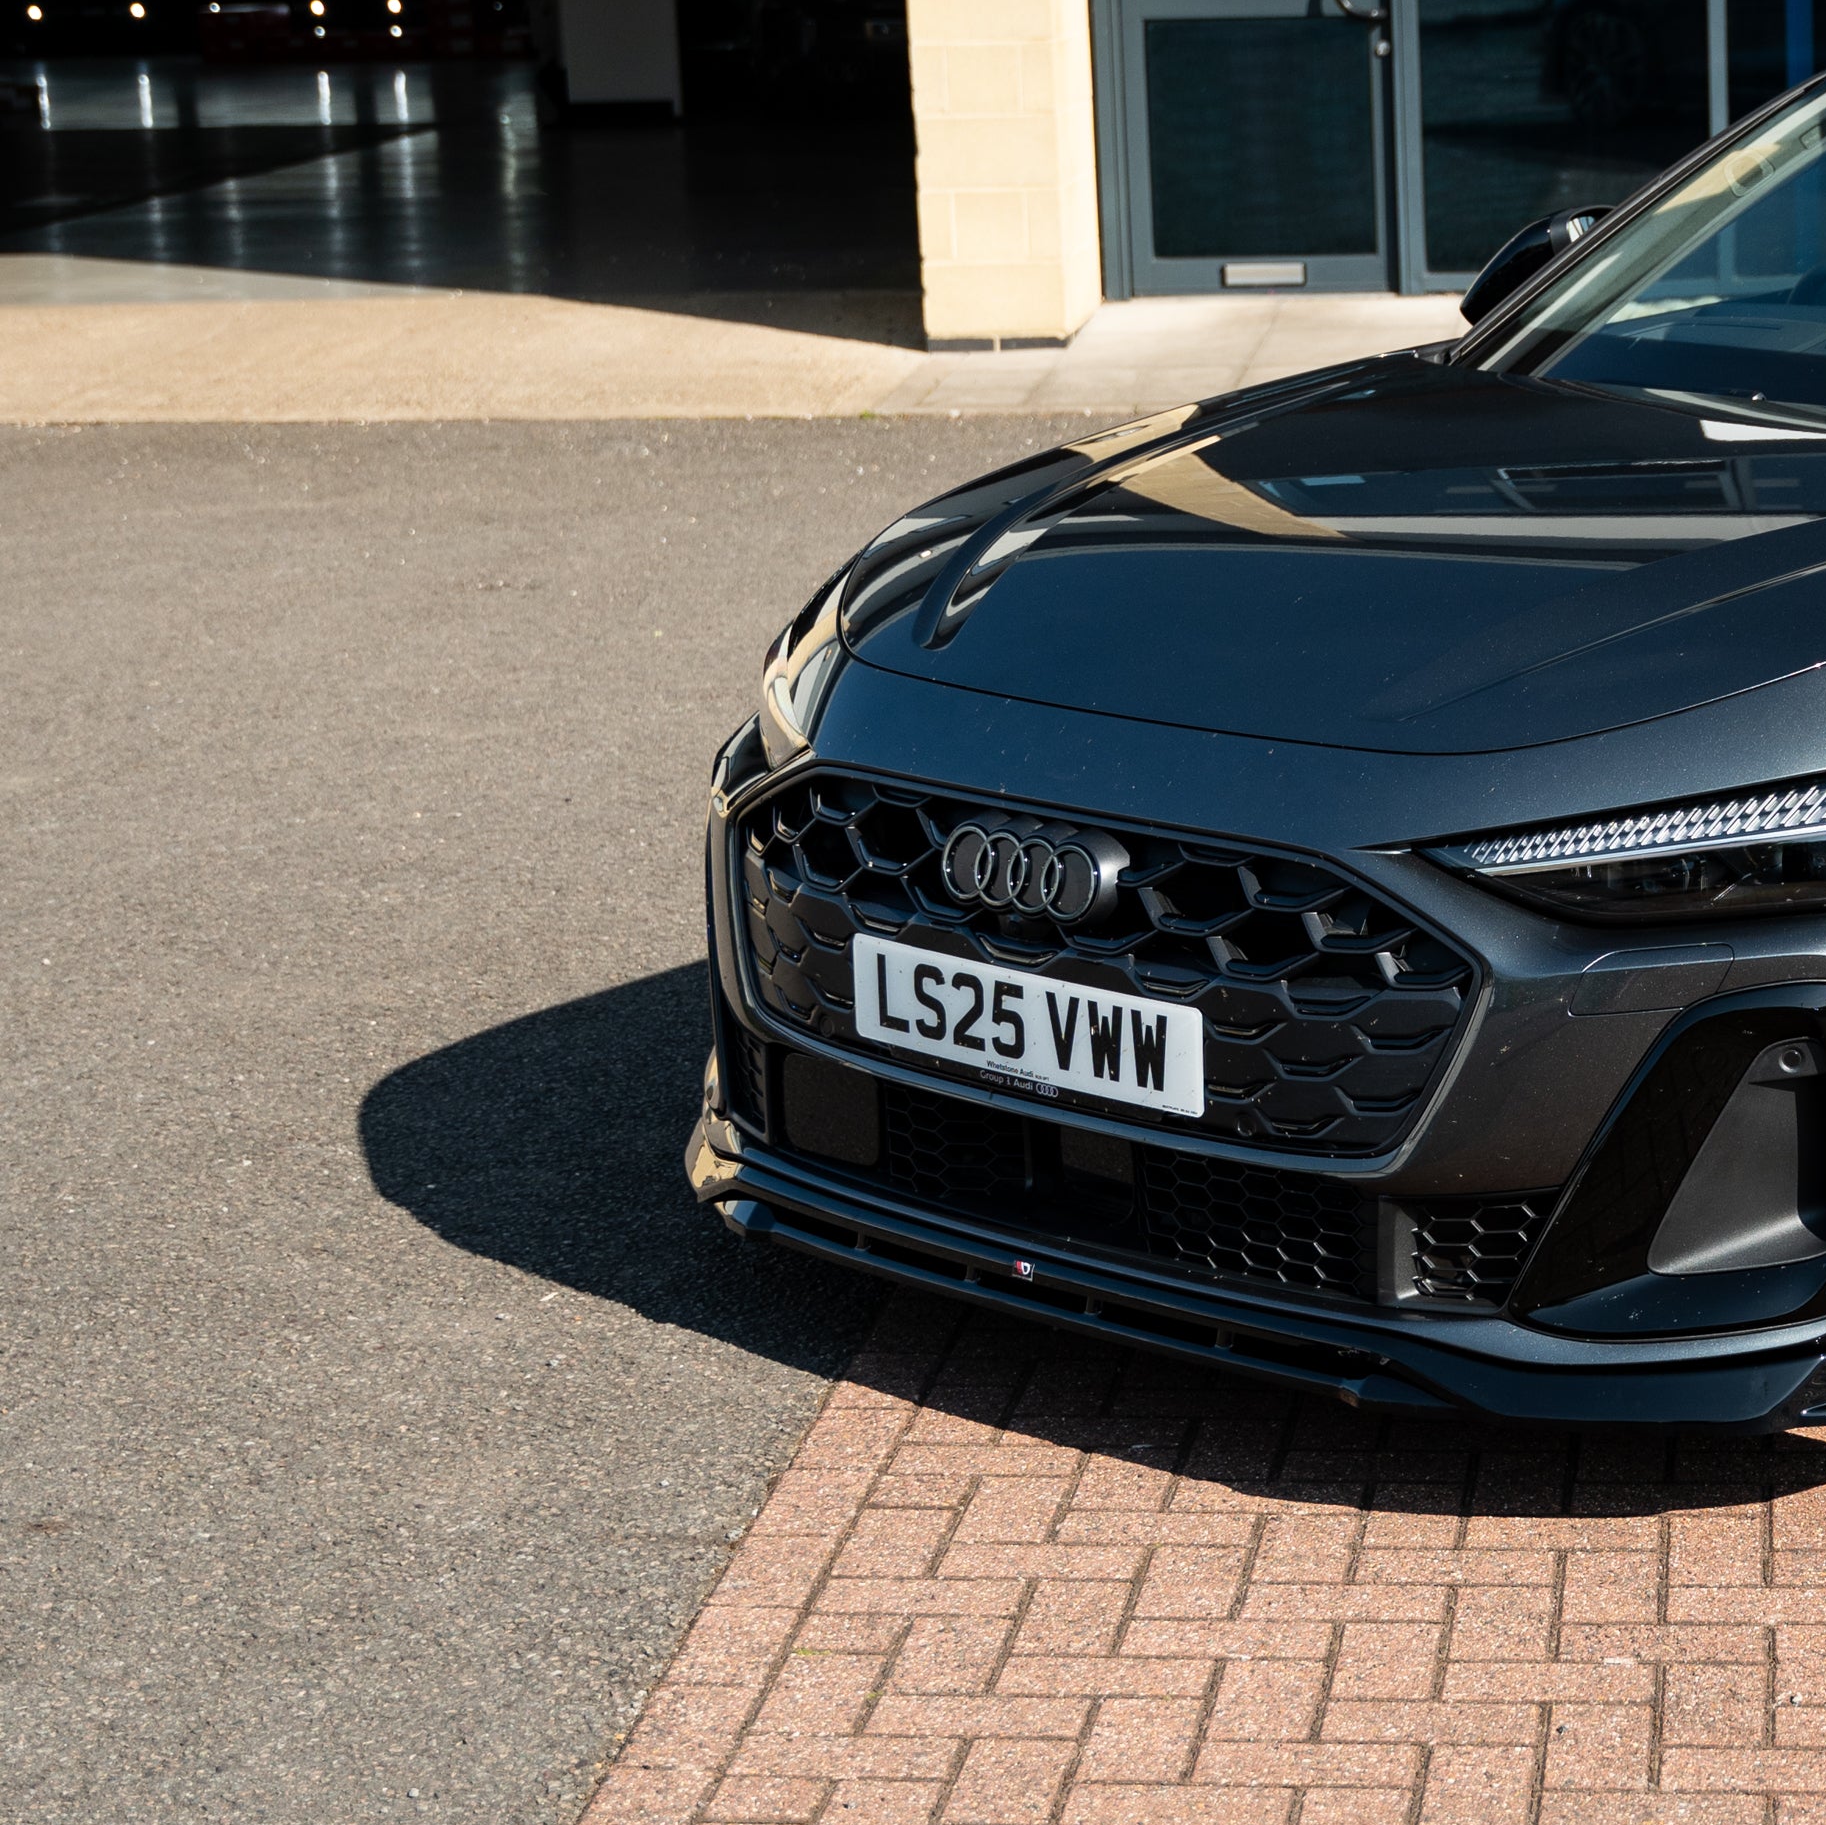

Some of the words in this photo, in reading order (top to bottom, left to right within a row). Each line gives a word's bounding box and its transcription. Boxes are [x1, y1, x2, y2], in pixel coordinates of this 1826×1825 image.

[876, 952, 1025, 1060] LS25
[1045, 990, 1168, 1092] VWW
[986, 1060, 1019, 1074] Whetstone
[1019, 1068, 1034, 1078] Audi
[979, 1070, 1005, 1084] Group
[1013, 1078, 1034, 1091] Audi
